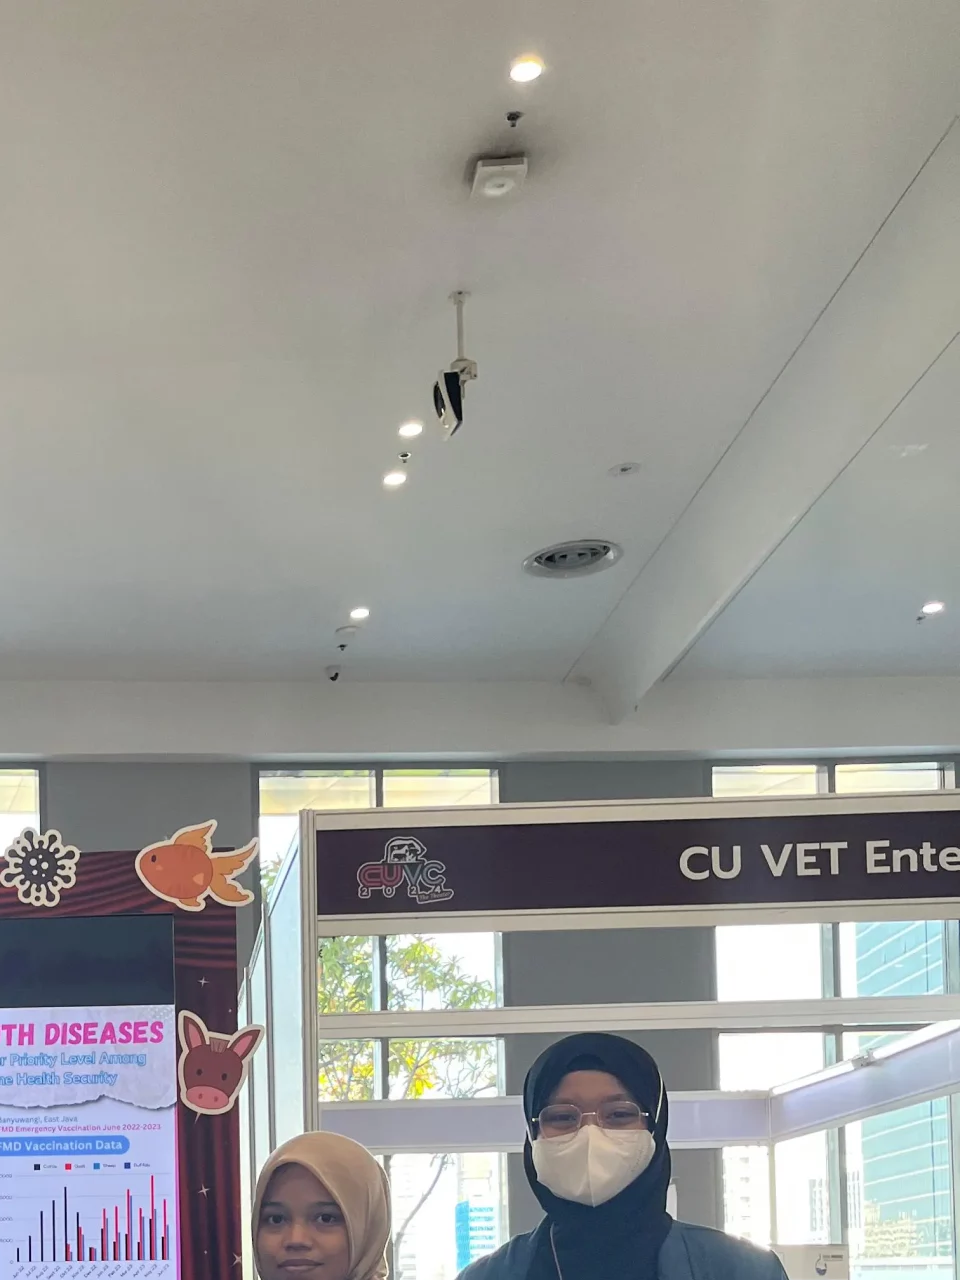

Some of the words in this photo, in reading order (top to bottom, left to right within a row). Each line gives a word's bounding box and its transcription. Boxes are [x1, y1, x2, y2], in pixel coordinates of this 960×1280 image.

[679, 845, 741, 880] CU
[760, 841, 848, 877] VET
[359, 860, 445, 887] CUVC
[45, 1021, 164, 1045] DISEASES
[9, 1052, 57, 1069] Priority
[60, 1051, 96, 1066] Level
[99, 1052, 147, 1068] Among
[16, 1072, 60, 1085] Health
[63, 1072, 118, 1087] Security
[16, 1125, 56, 1133] Emergency
[58, 1124, 101, 1132] Vaccination
[122, 1123, 161, 1131] 2022-2023
[25, 1141, 93, 1151] Vaccination
[95, 1140, 123, 1150] Data
